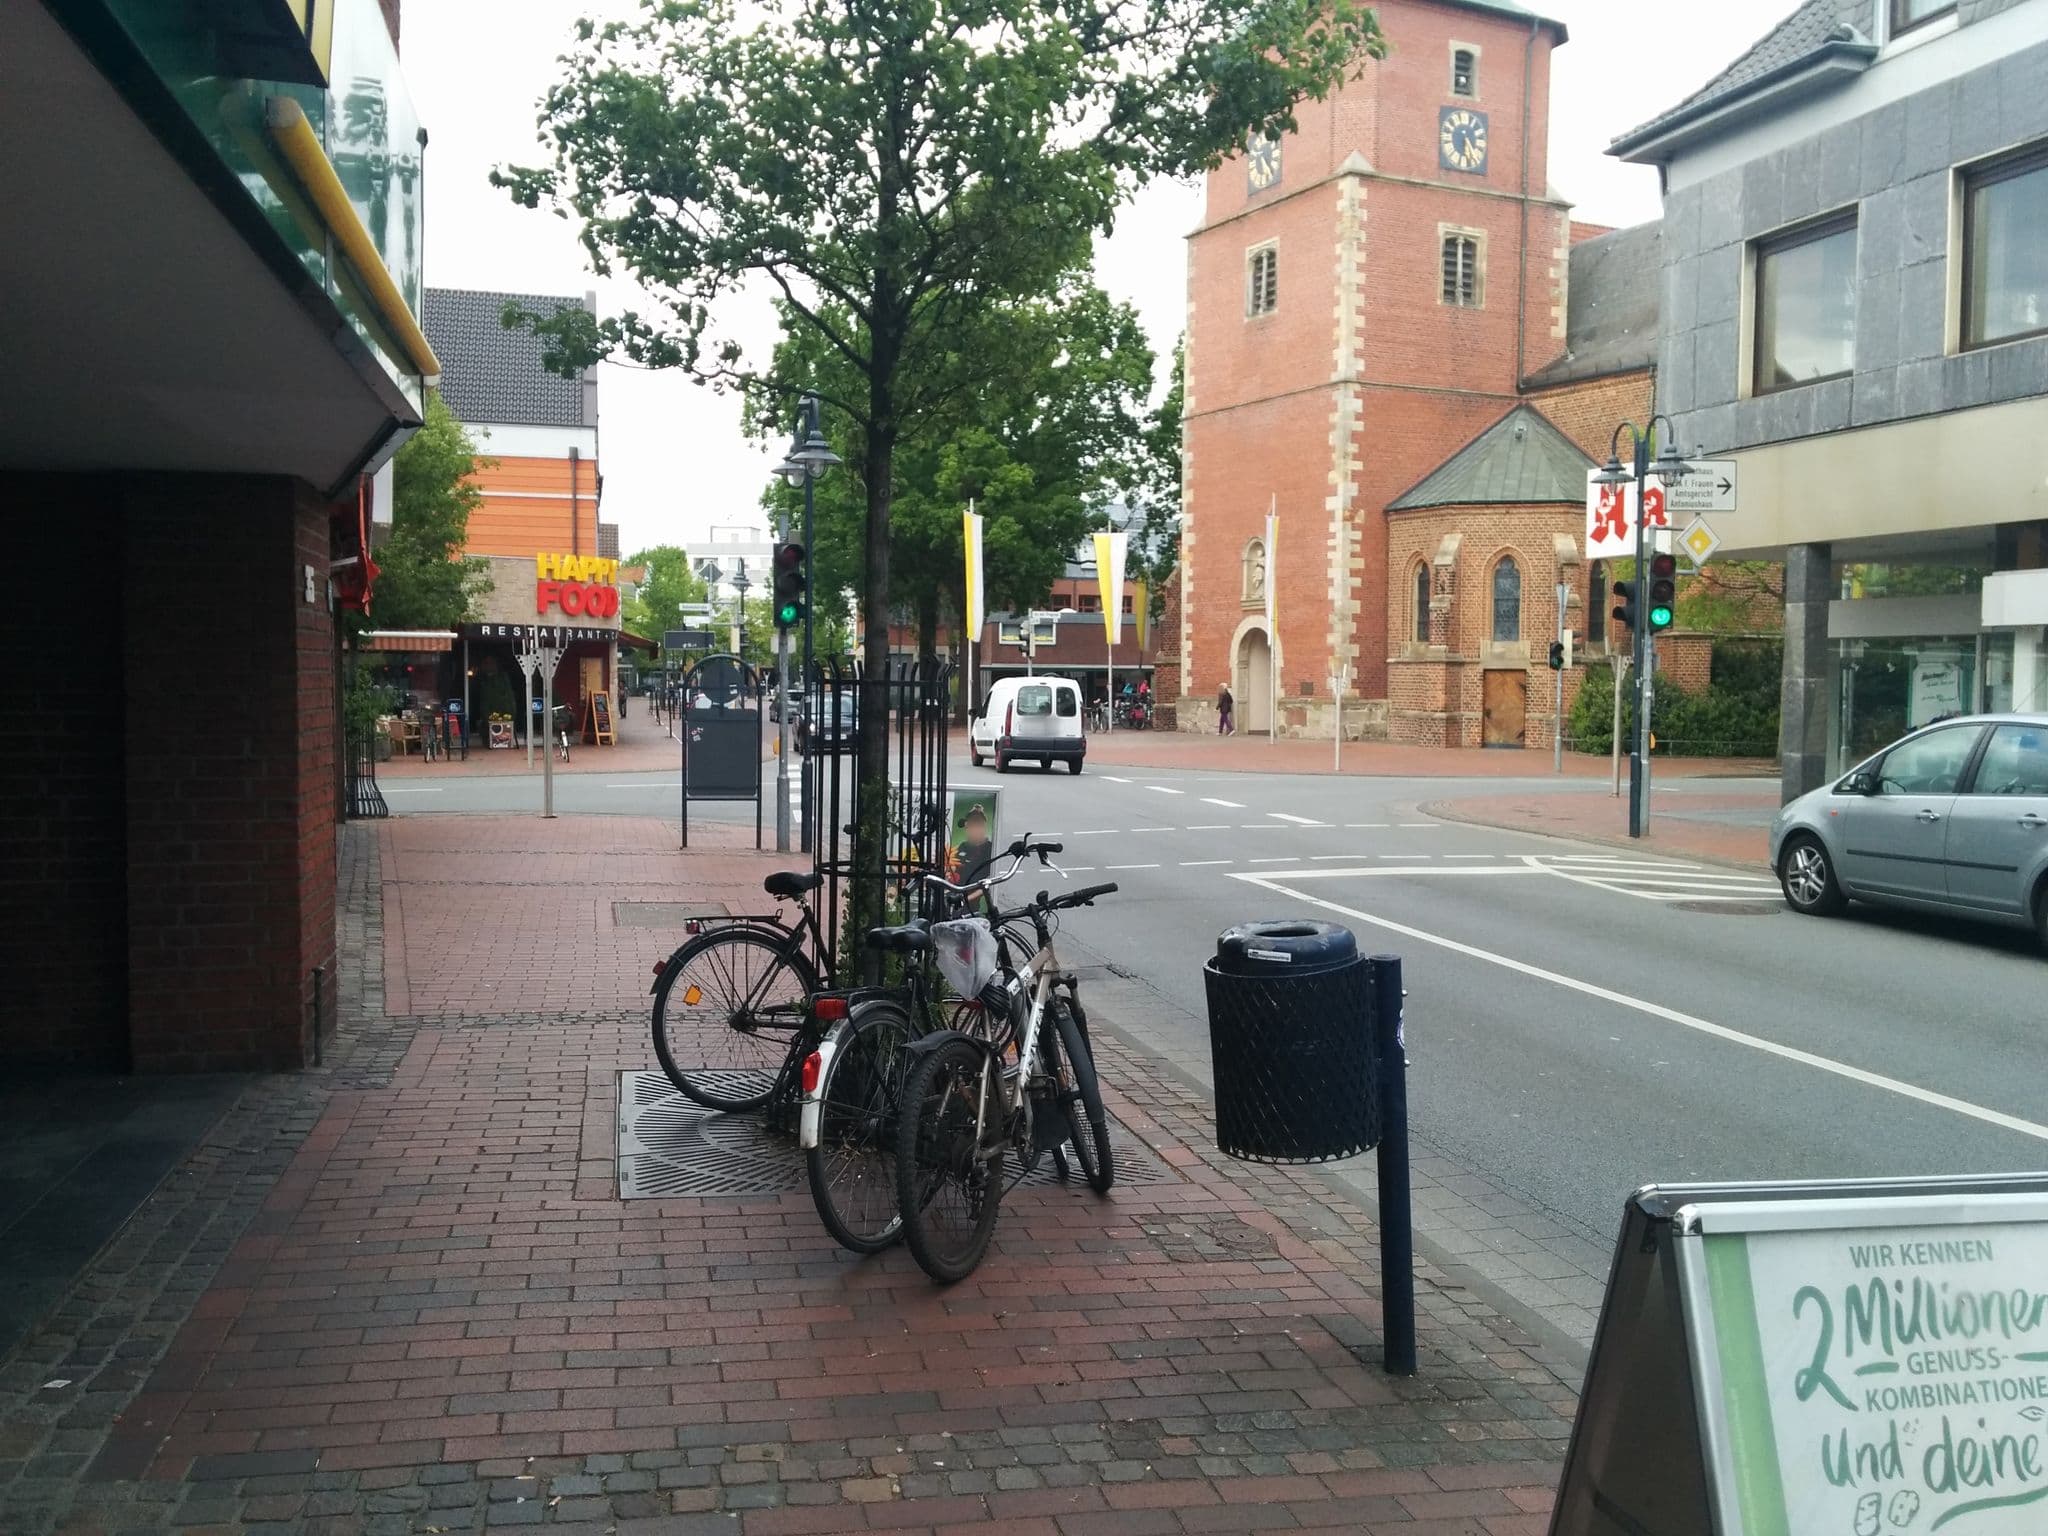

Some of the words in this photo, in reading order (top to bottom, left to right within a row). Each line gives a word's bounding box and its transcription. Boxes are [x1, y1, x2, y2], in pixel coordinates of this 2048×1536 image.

[1675, 489, 1713, 498] Amtsgericht
[537, 552, 618, 584] HAPPY
[537, 580, 619, 618] FOOD
[481, 625, 601, 641] RESTAURANT
[1849, 1244, 1895, 1268] WIR
[1899, 1239, 1994, 1266] KENNEN
[1792, 1285, 1859, 1412] 2
[1907, 1347, 2009, 1375] GENUSS-
[1923, 1414, 2043, 1494] deine
